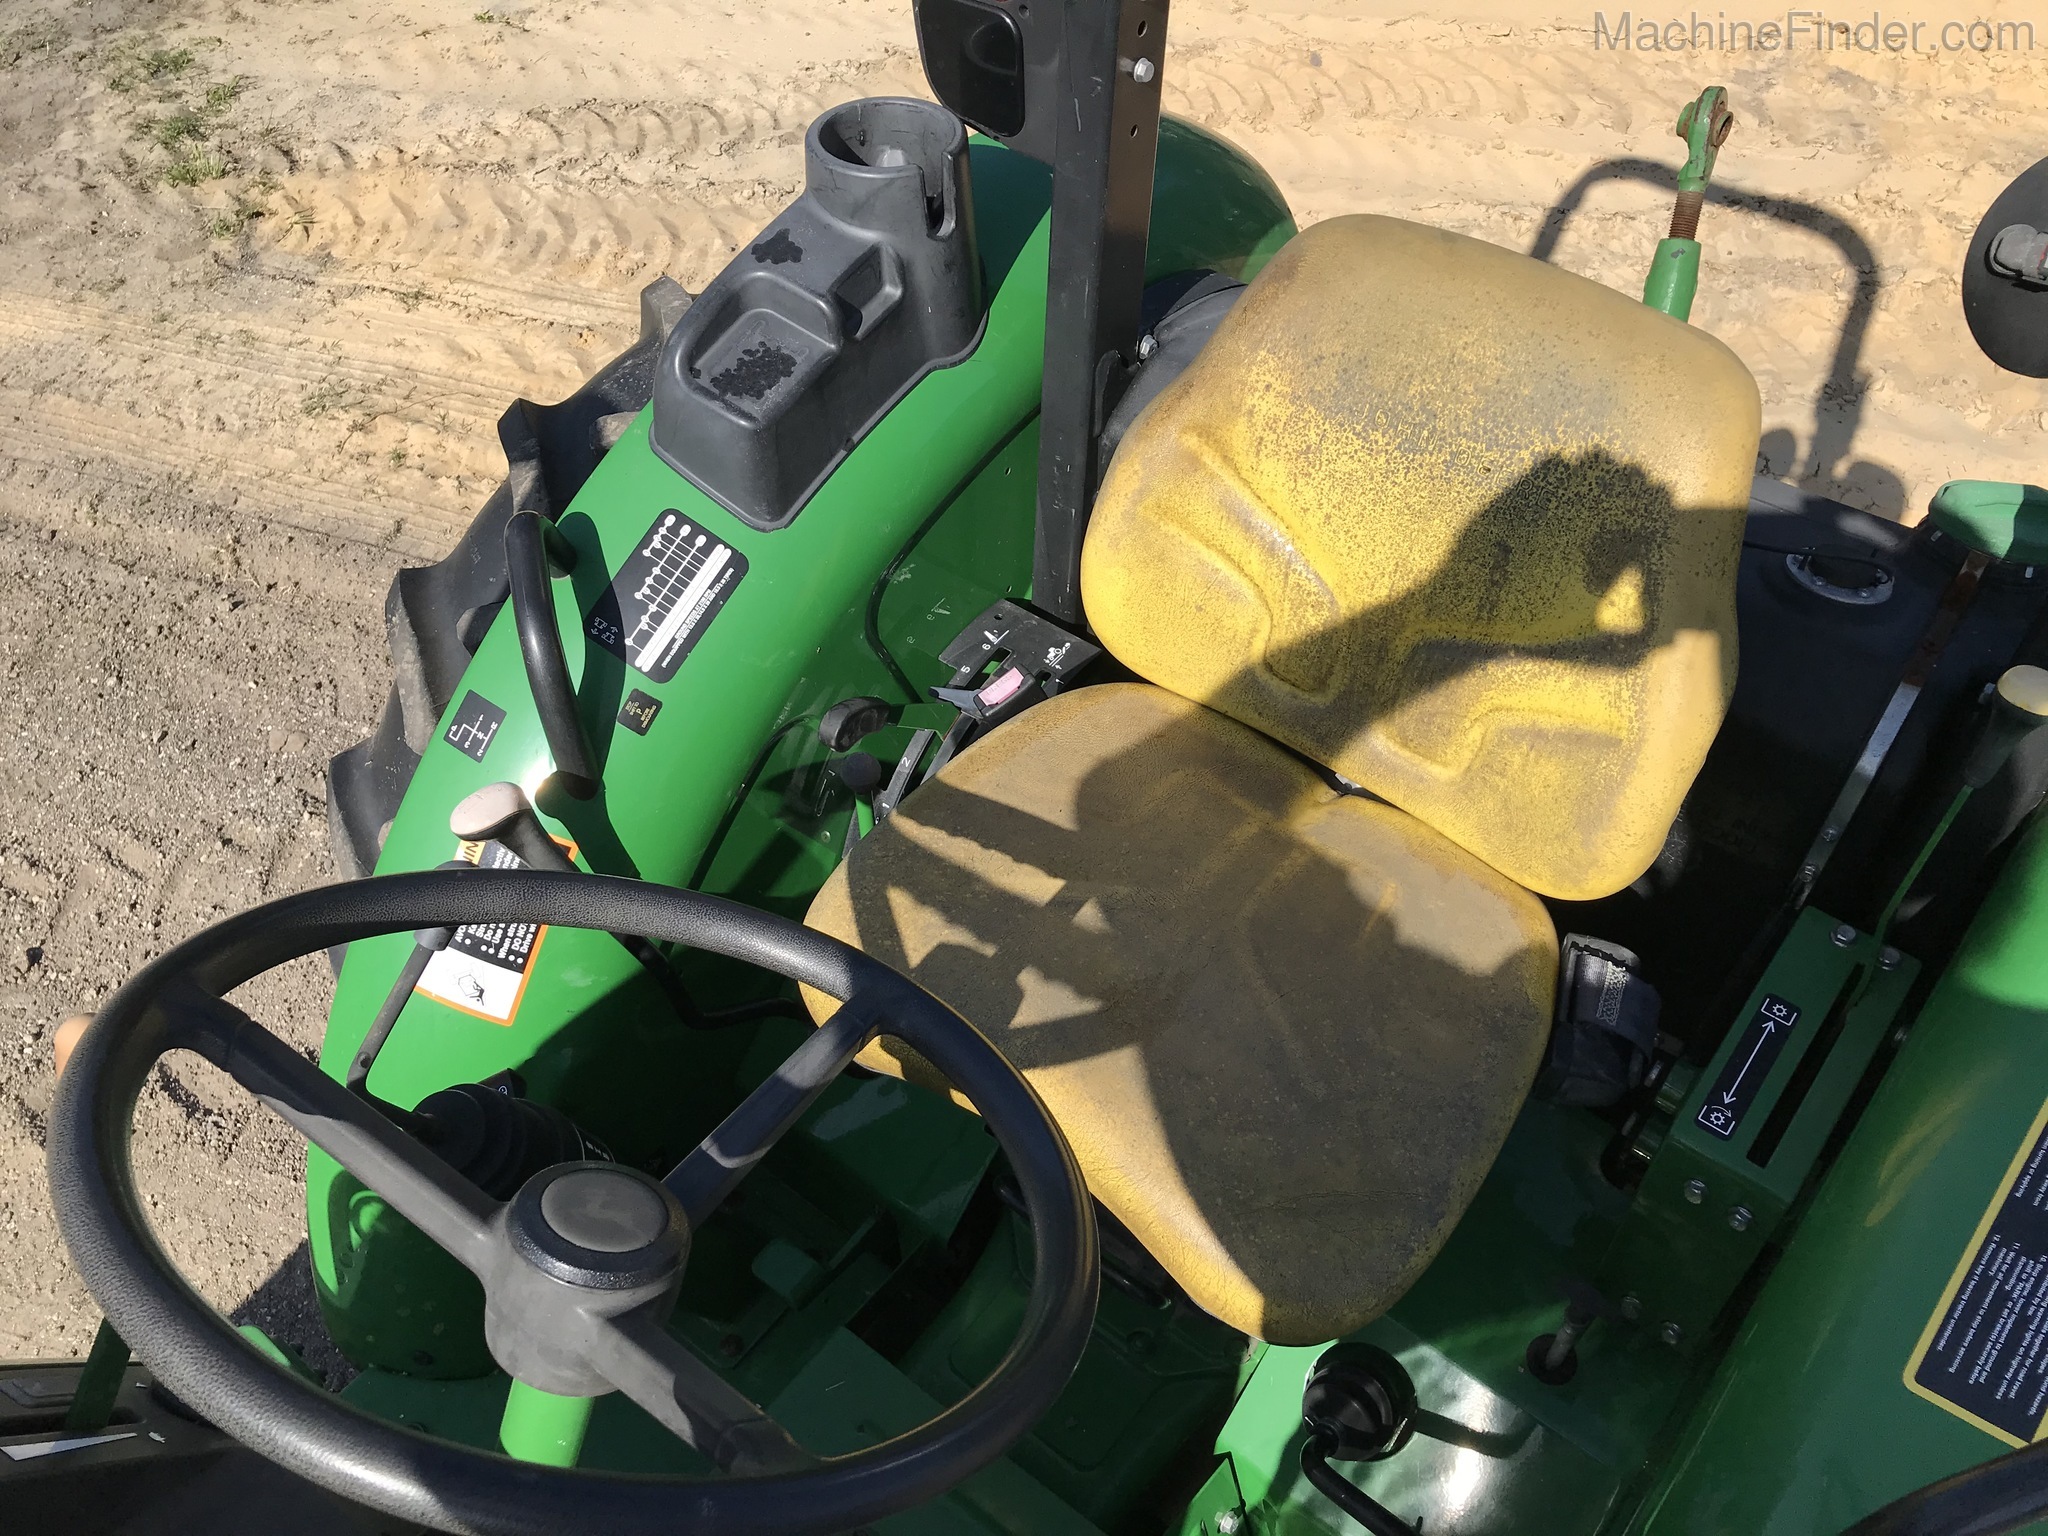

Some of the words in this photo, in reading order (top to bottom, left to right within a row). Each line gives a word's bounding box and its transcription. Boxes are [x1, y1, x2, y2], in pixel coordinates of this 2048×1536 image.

[1354, 403, 1440, 451] JOHN
[1454, 446, 1557, 511] DEERE
[960, 665, 970, 674] 5
[477, 731, 484, 740] N
[490, 722, 498, 730] R
[484, 929, 494, 941] Do
[492, 928, 503, 944] Use
[511, 937, 522, 950] DO
[520, 933, 534, 954] Drive
[497, 937, 512, 958] When
[1980, 1242, 1997, 1265] Remove
[2005, 1251, 2016, 1264] Wait
[2032, 1263, 2043, 1277] Stop
[1982, 1279, 2000, 1309] movement
[1953, 1300, 1967, 1319] tractor
[2013, 1297, 2026, 1314] lower
[1963, 1328, 1976, 1347] before
[1998, 1313, 2018, 1344] implement
[1948, 1347, 1966, 1373] servicing
[1976, 1341, 1993, 1366] securely
[1984, 1349, 1998, 1372] ground
[1968, 1365, 1982, 1384] before
[1979, 1371, 1988, 1384] and
